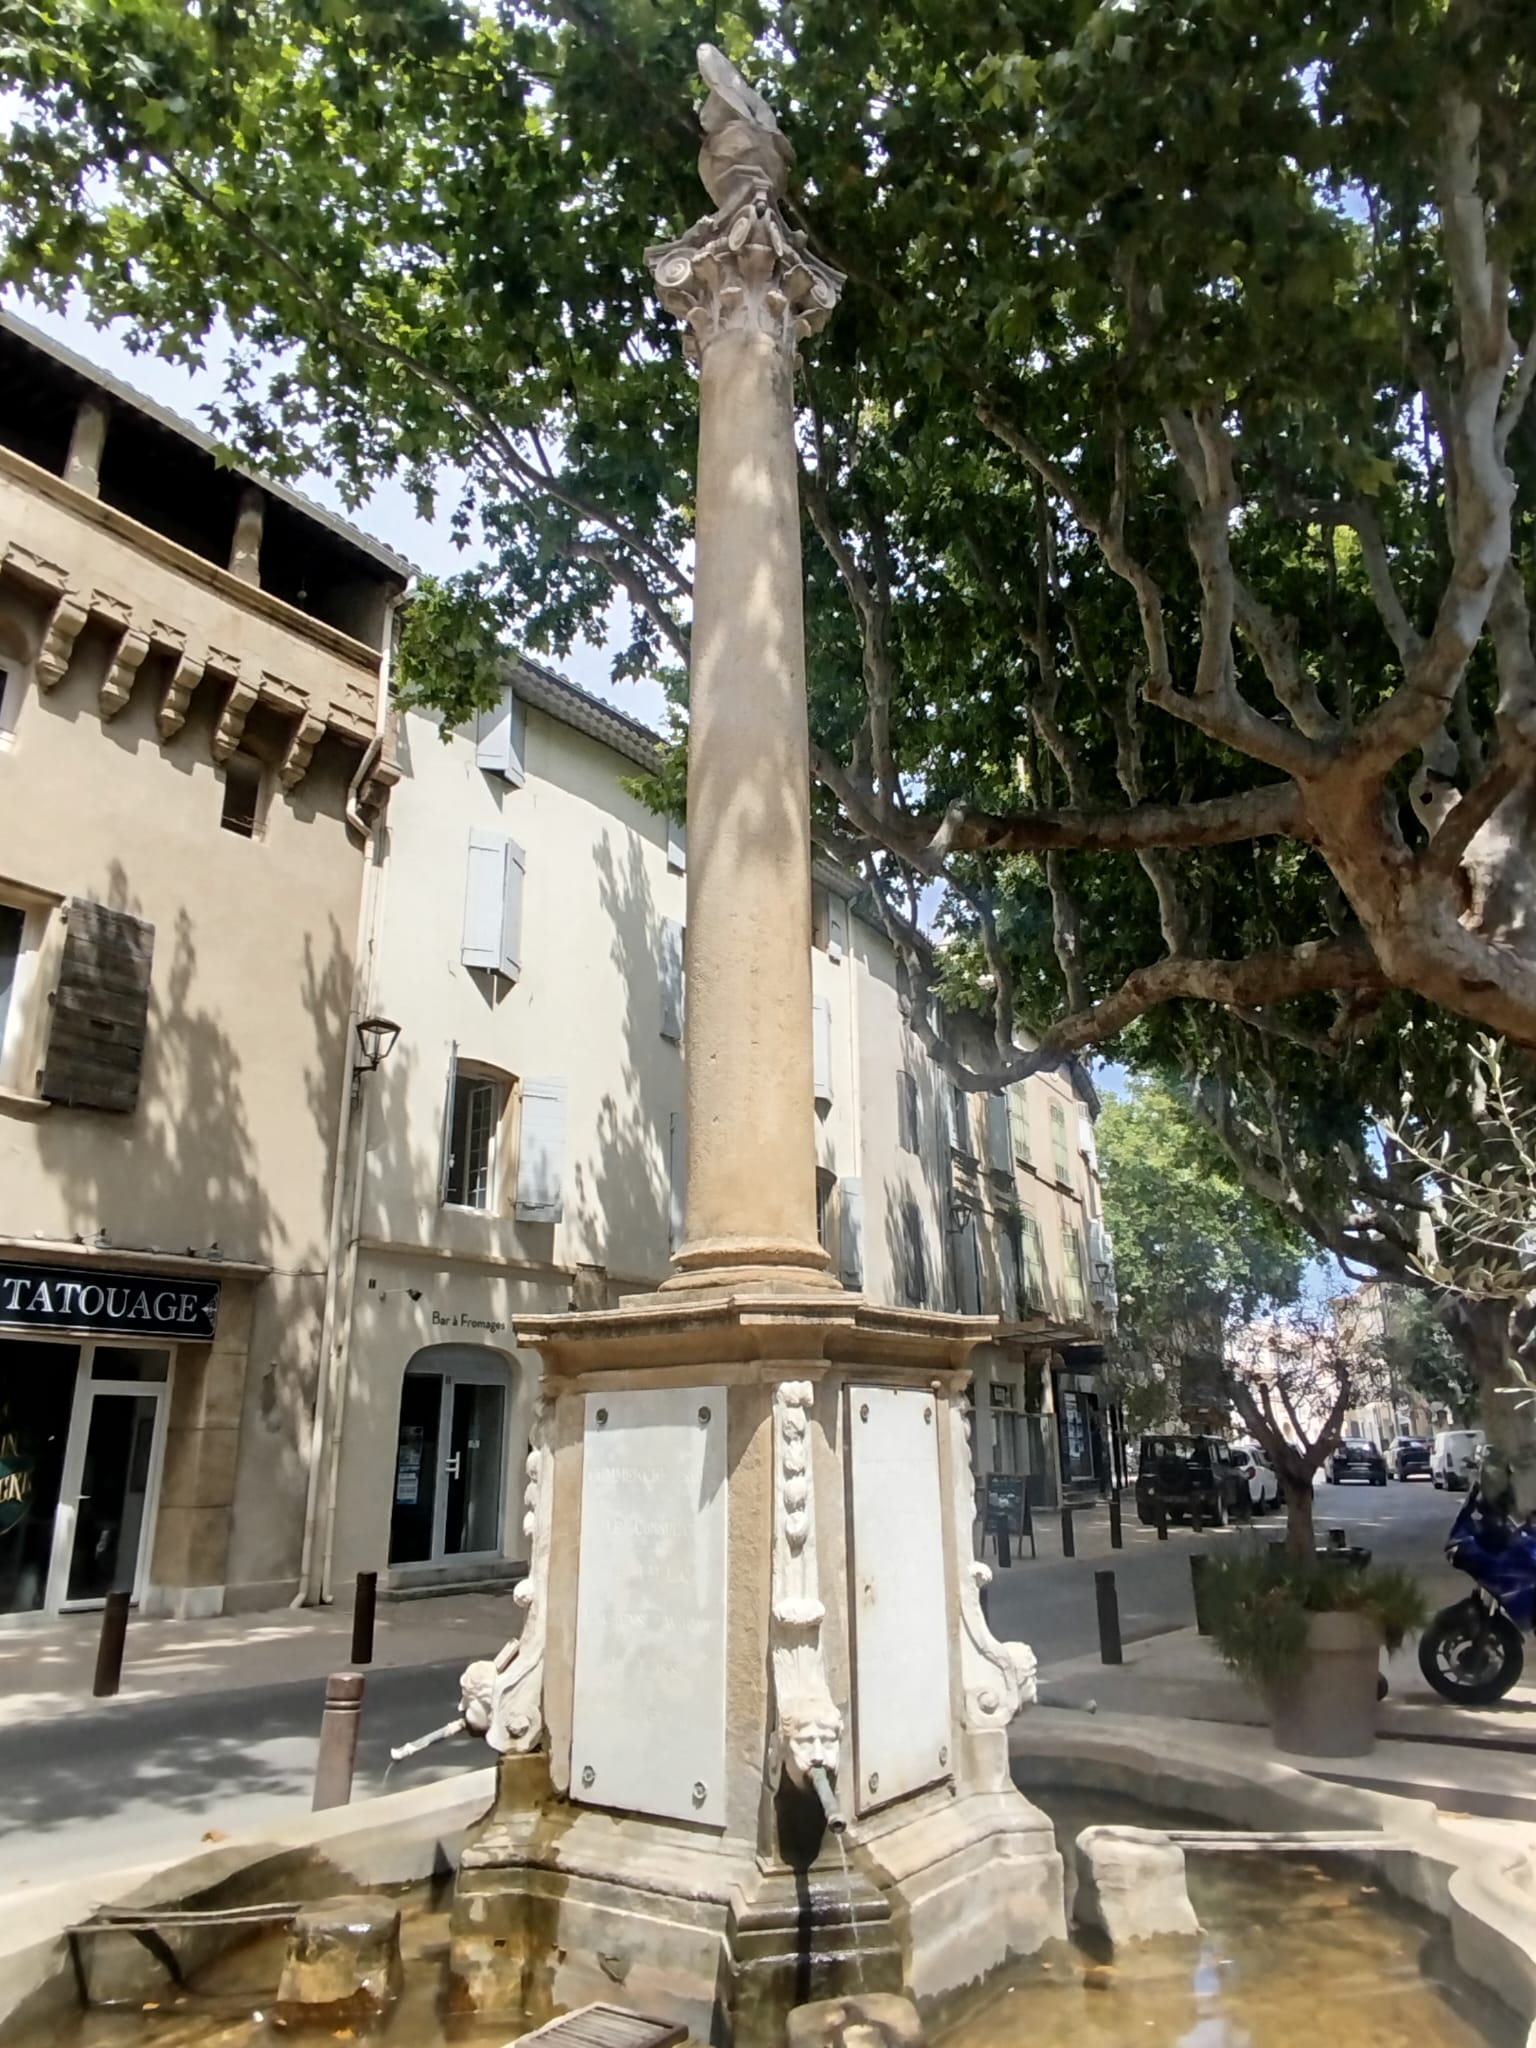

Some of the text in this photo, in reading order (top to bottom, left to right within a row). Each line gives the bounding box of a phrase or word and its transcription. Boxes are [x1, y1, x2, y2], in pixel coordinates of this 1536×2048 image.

[3, 1278, 198, 1323] TATOUAGE
[432, 1310, 505, 1333] Bar à Fromages
